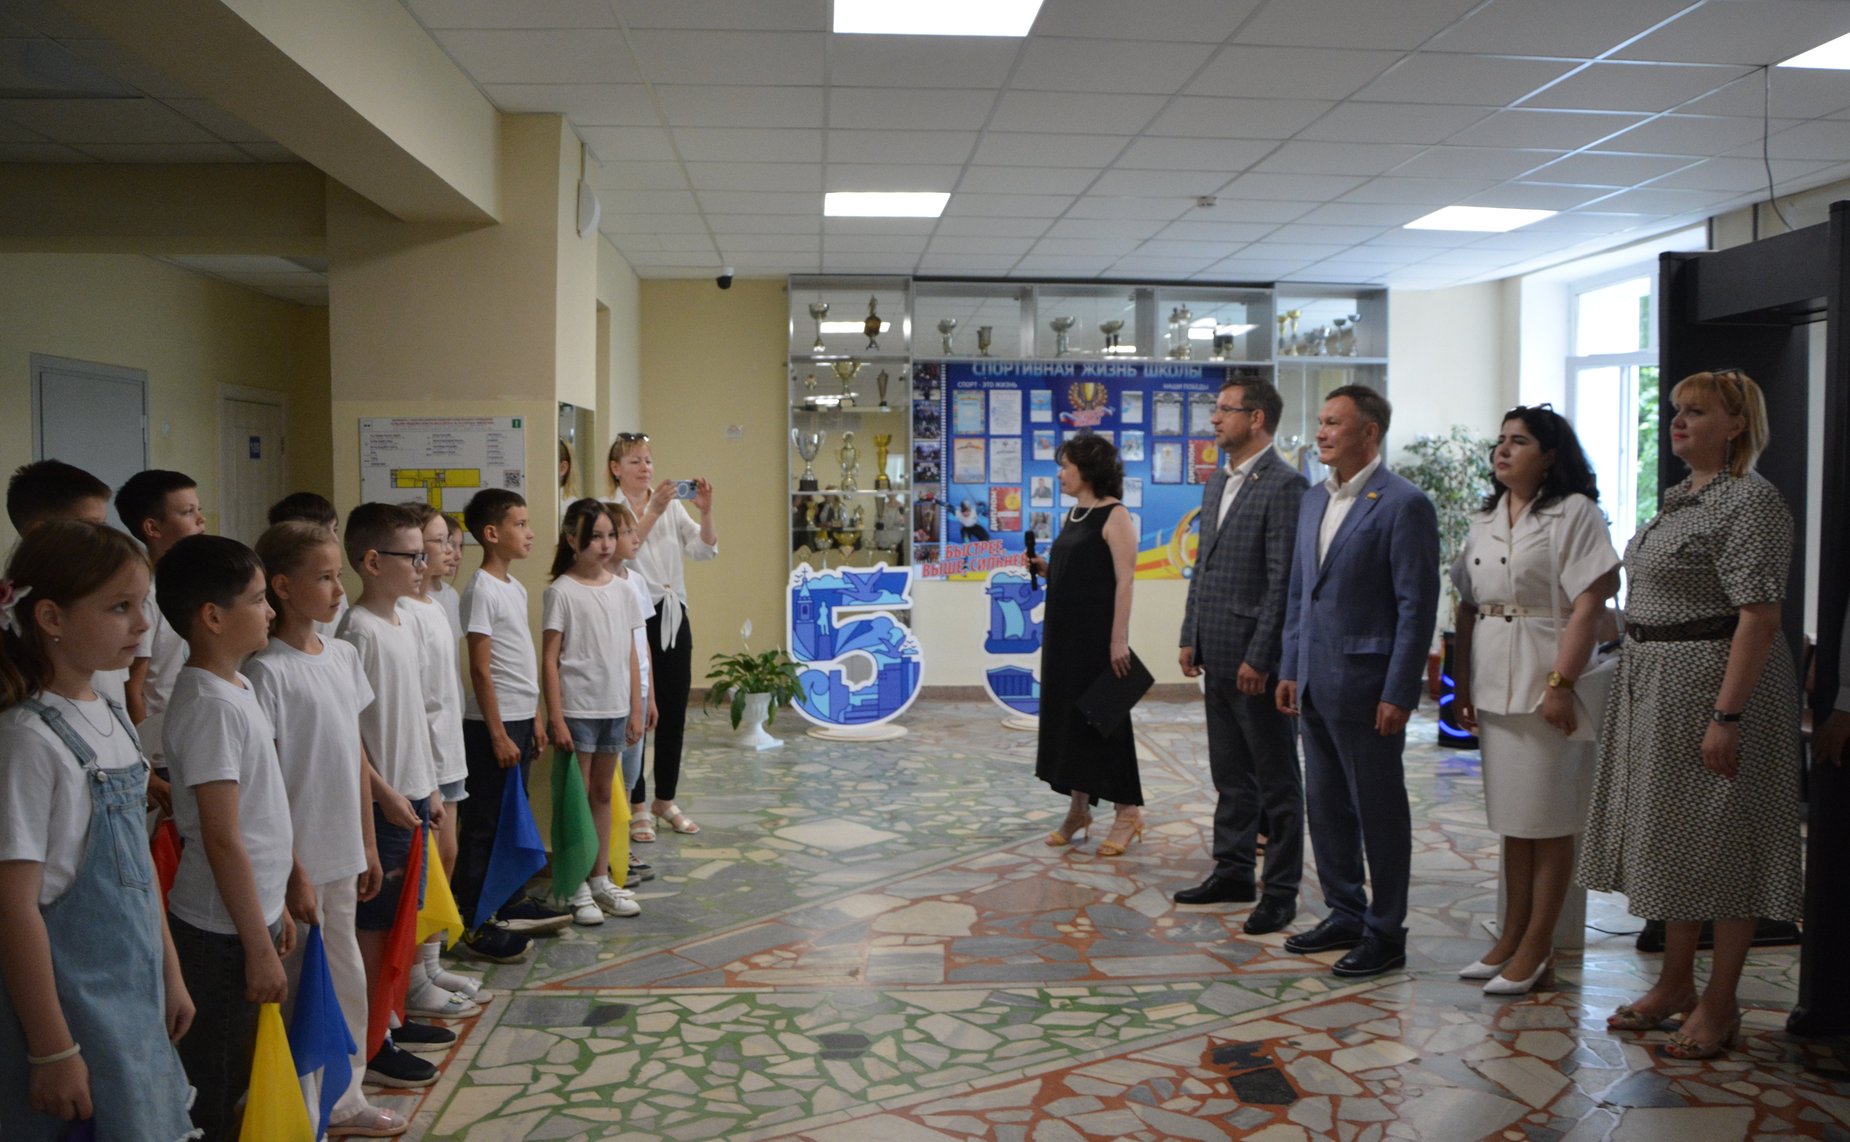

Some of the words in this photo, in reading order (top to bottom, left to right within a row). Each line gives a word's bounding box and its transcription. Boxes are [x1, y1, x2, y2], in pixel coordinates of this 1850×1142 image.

[972, 363, 1074, 377] СПОРТИВНАЯ
[1081, 363, 1137, 378] ЖИЗНЬ
[1144, 363, 1203, 378] ШКОЛЫ
[946, 540, 1007, 558] БЫСТРЕЕ,
